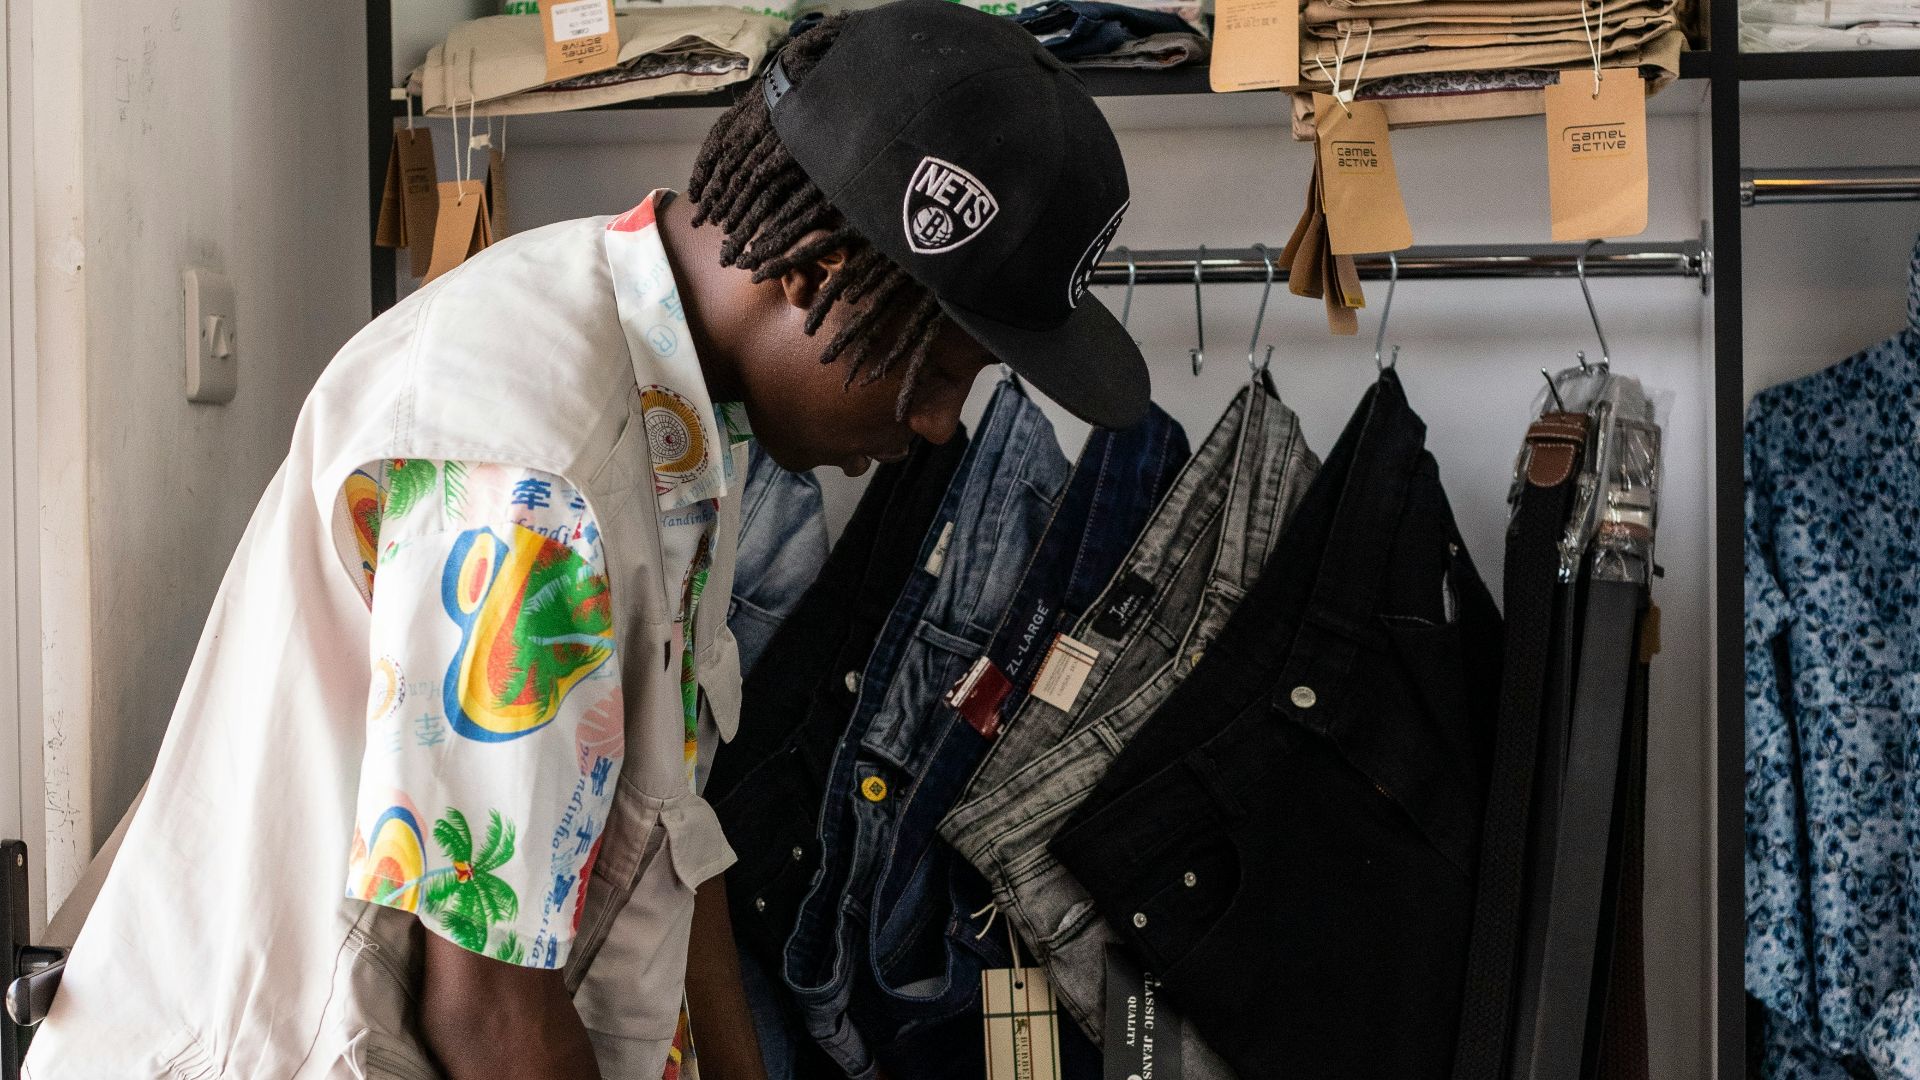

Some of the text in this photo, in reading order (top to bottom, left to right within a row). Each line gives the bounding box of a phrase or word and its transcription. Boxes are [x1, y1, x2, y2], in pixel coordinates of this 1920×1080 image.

[914, 163, 990, 229] NETS
[1126, 995, 1137, 1047] QUALITY
[1142, 971, 1155, 1080] CLASSIC JEANS
